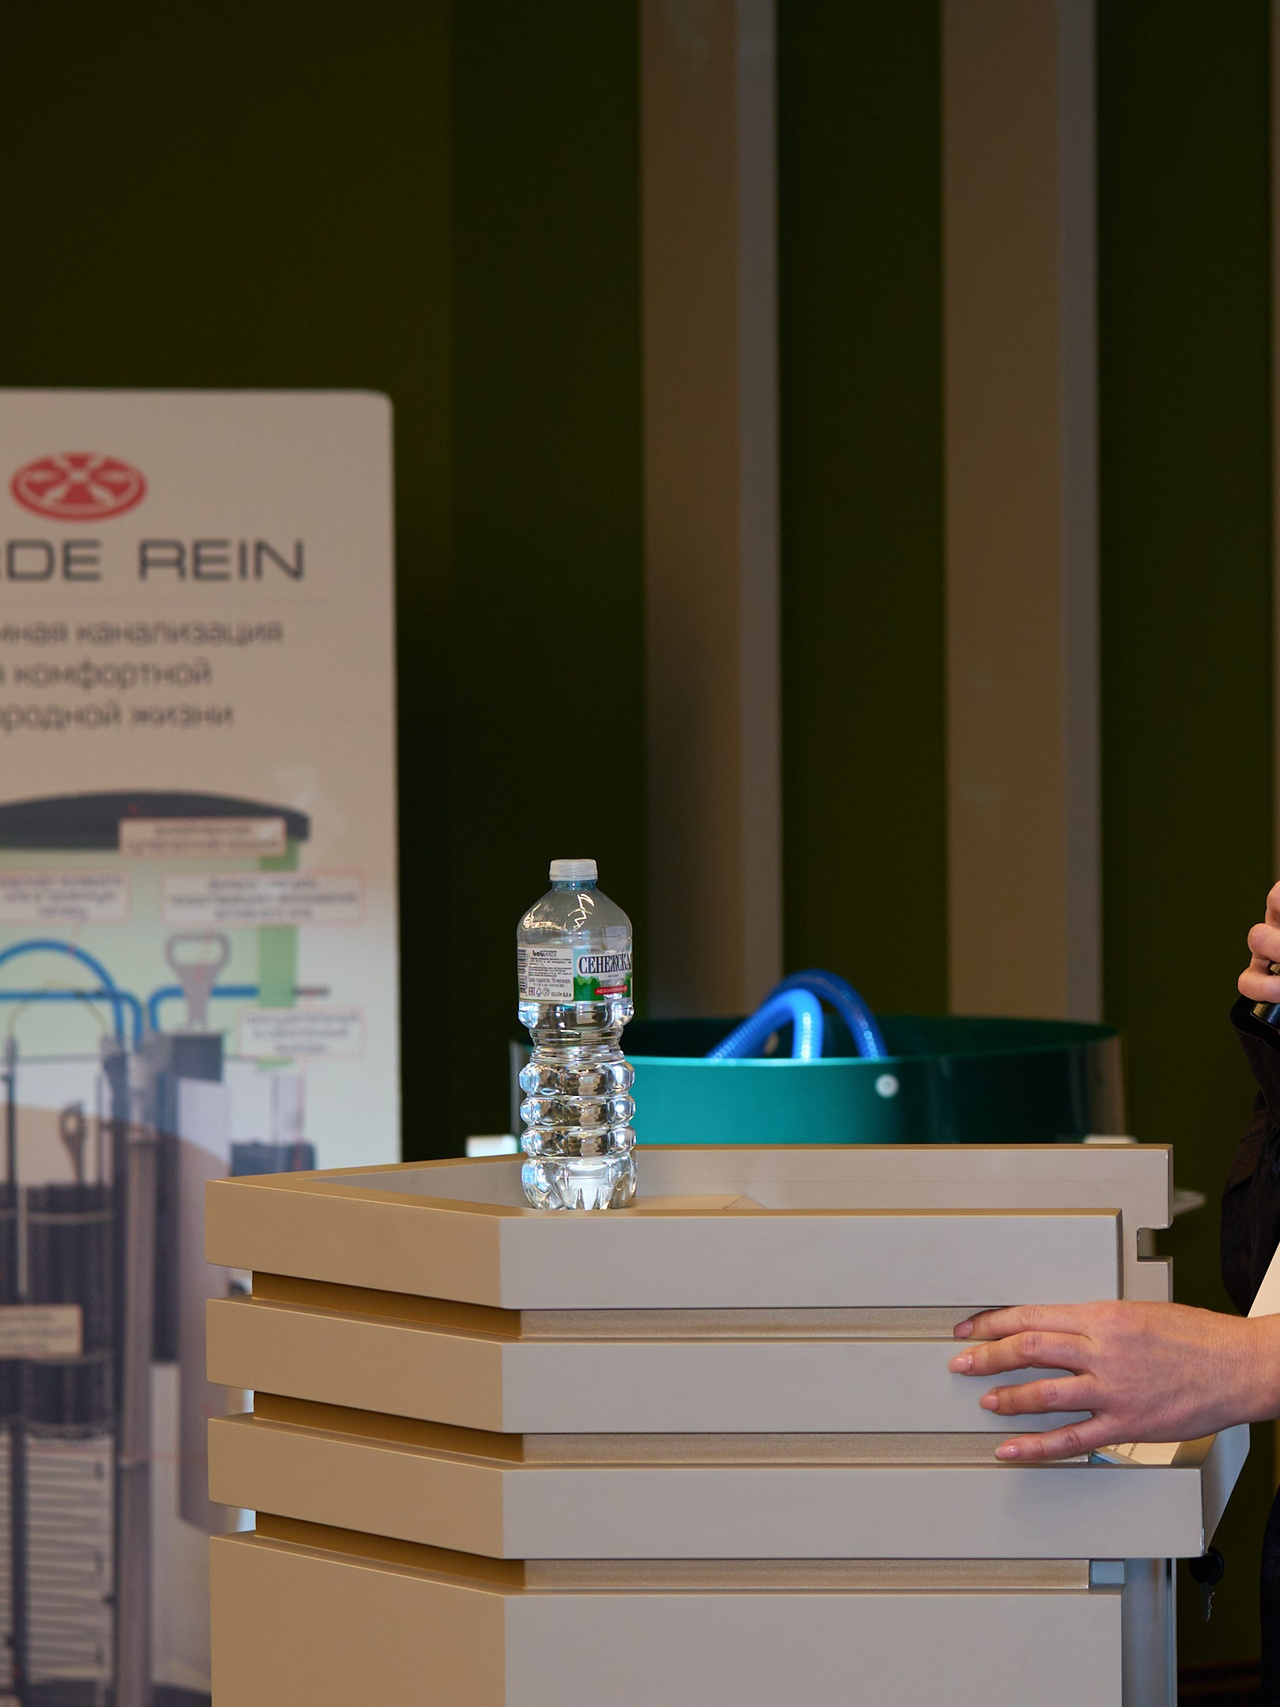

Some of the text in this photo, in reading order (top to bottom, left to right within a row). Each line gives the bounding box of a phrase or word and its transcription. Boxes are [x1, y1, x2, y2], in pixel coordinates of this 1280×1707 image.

[0, 538, 305, 582] DE REIN
[76, 620, 285, 648] канализация
[13, 655, 213, 692] комфортной
[131, 704, 234, 728] жизни
